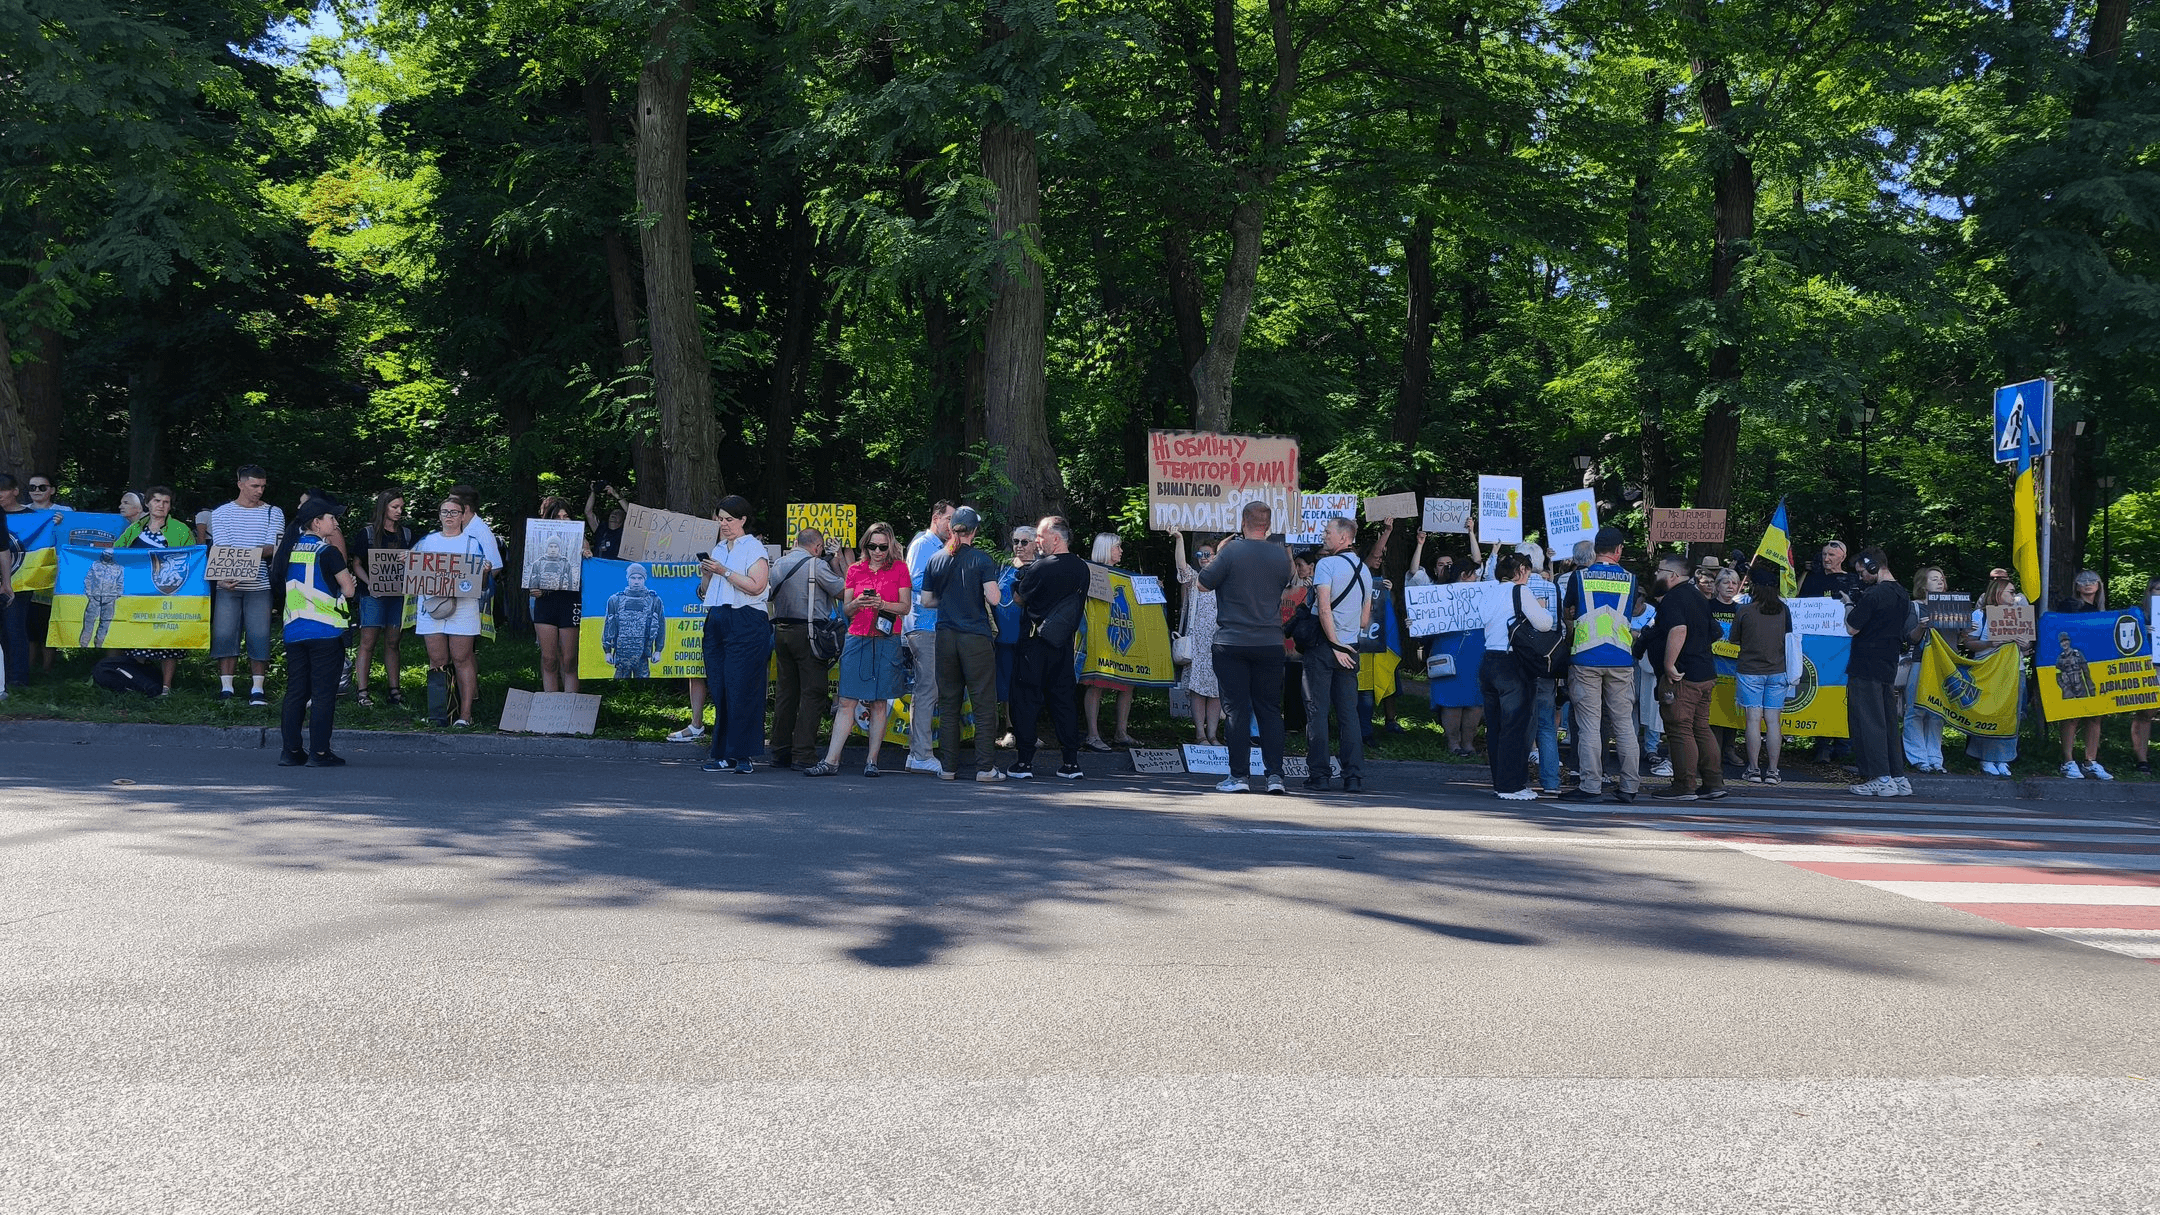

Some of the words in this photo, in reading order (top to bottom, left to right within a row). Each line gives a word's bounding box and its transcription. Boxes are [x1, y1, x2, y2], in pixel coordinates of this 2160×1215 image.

[1174, 431, 1247, 458] ОБМІНУ
[1157, 482, 1222, 497] ВИМАГАЄМО
[789, 504, 804, 516] 47
[1482, 501, 1508, 510] KREMLIN
[1312, 511, 1344, 519] DEMAND
[1432, 513, 1462, 524] NOW
[1482, 510, 1507, 518] CAPTIVES
[1550, 510, 1564, 518] FREE
[1565, 508, 1575, 516] ALL
[1550, 516, 1580, 527] KREMLIN
[1551, 524, 1580, 535] CAPTIVES
[218, 548, 252, 558] FREE
[210, 558, 259, 568] AZOVSTAL
[409, 552, 461, 573] FREE
[466, 554, 486, 575] 47
[206, 567, 258, 578] DEFENDERS
[371, 564, 404, 575] SWAP
[652, 564, 704, 578] МАЛОРО
[1408, 587, 1442, 605] Land
[1804, 609, 1836, 619] demand
[678, 620, 690, 632] 47
[692, 620, 704, 631] БР
[681, 637, 702, 648] «МА
[662, 666, 672, 675] ЯК
[674, 666, 684, 675] ТИ
[686, 666, 706, 675] БОРО
[1795, 720, 1818, 729] 3057
[1975, 722, 1997, 730] 2022
